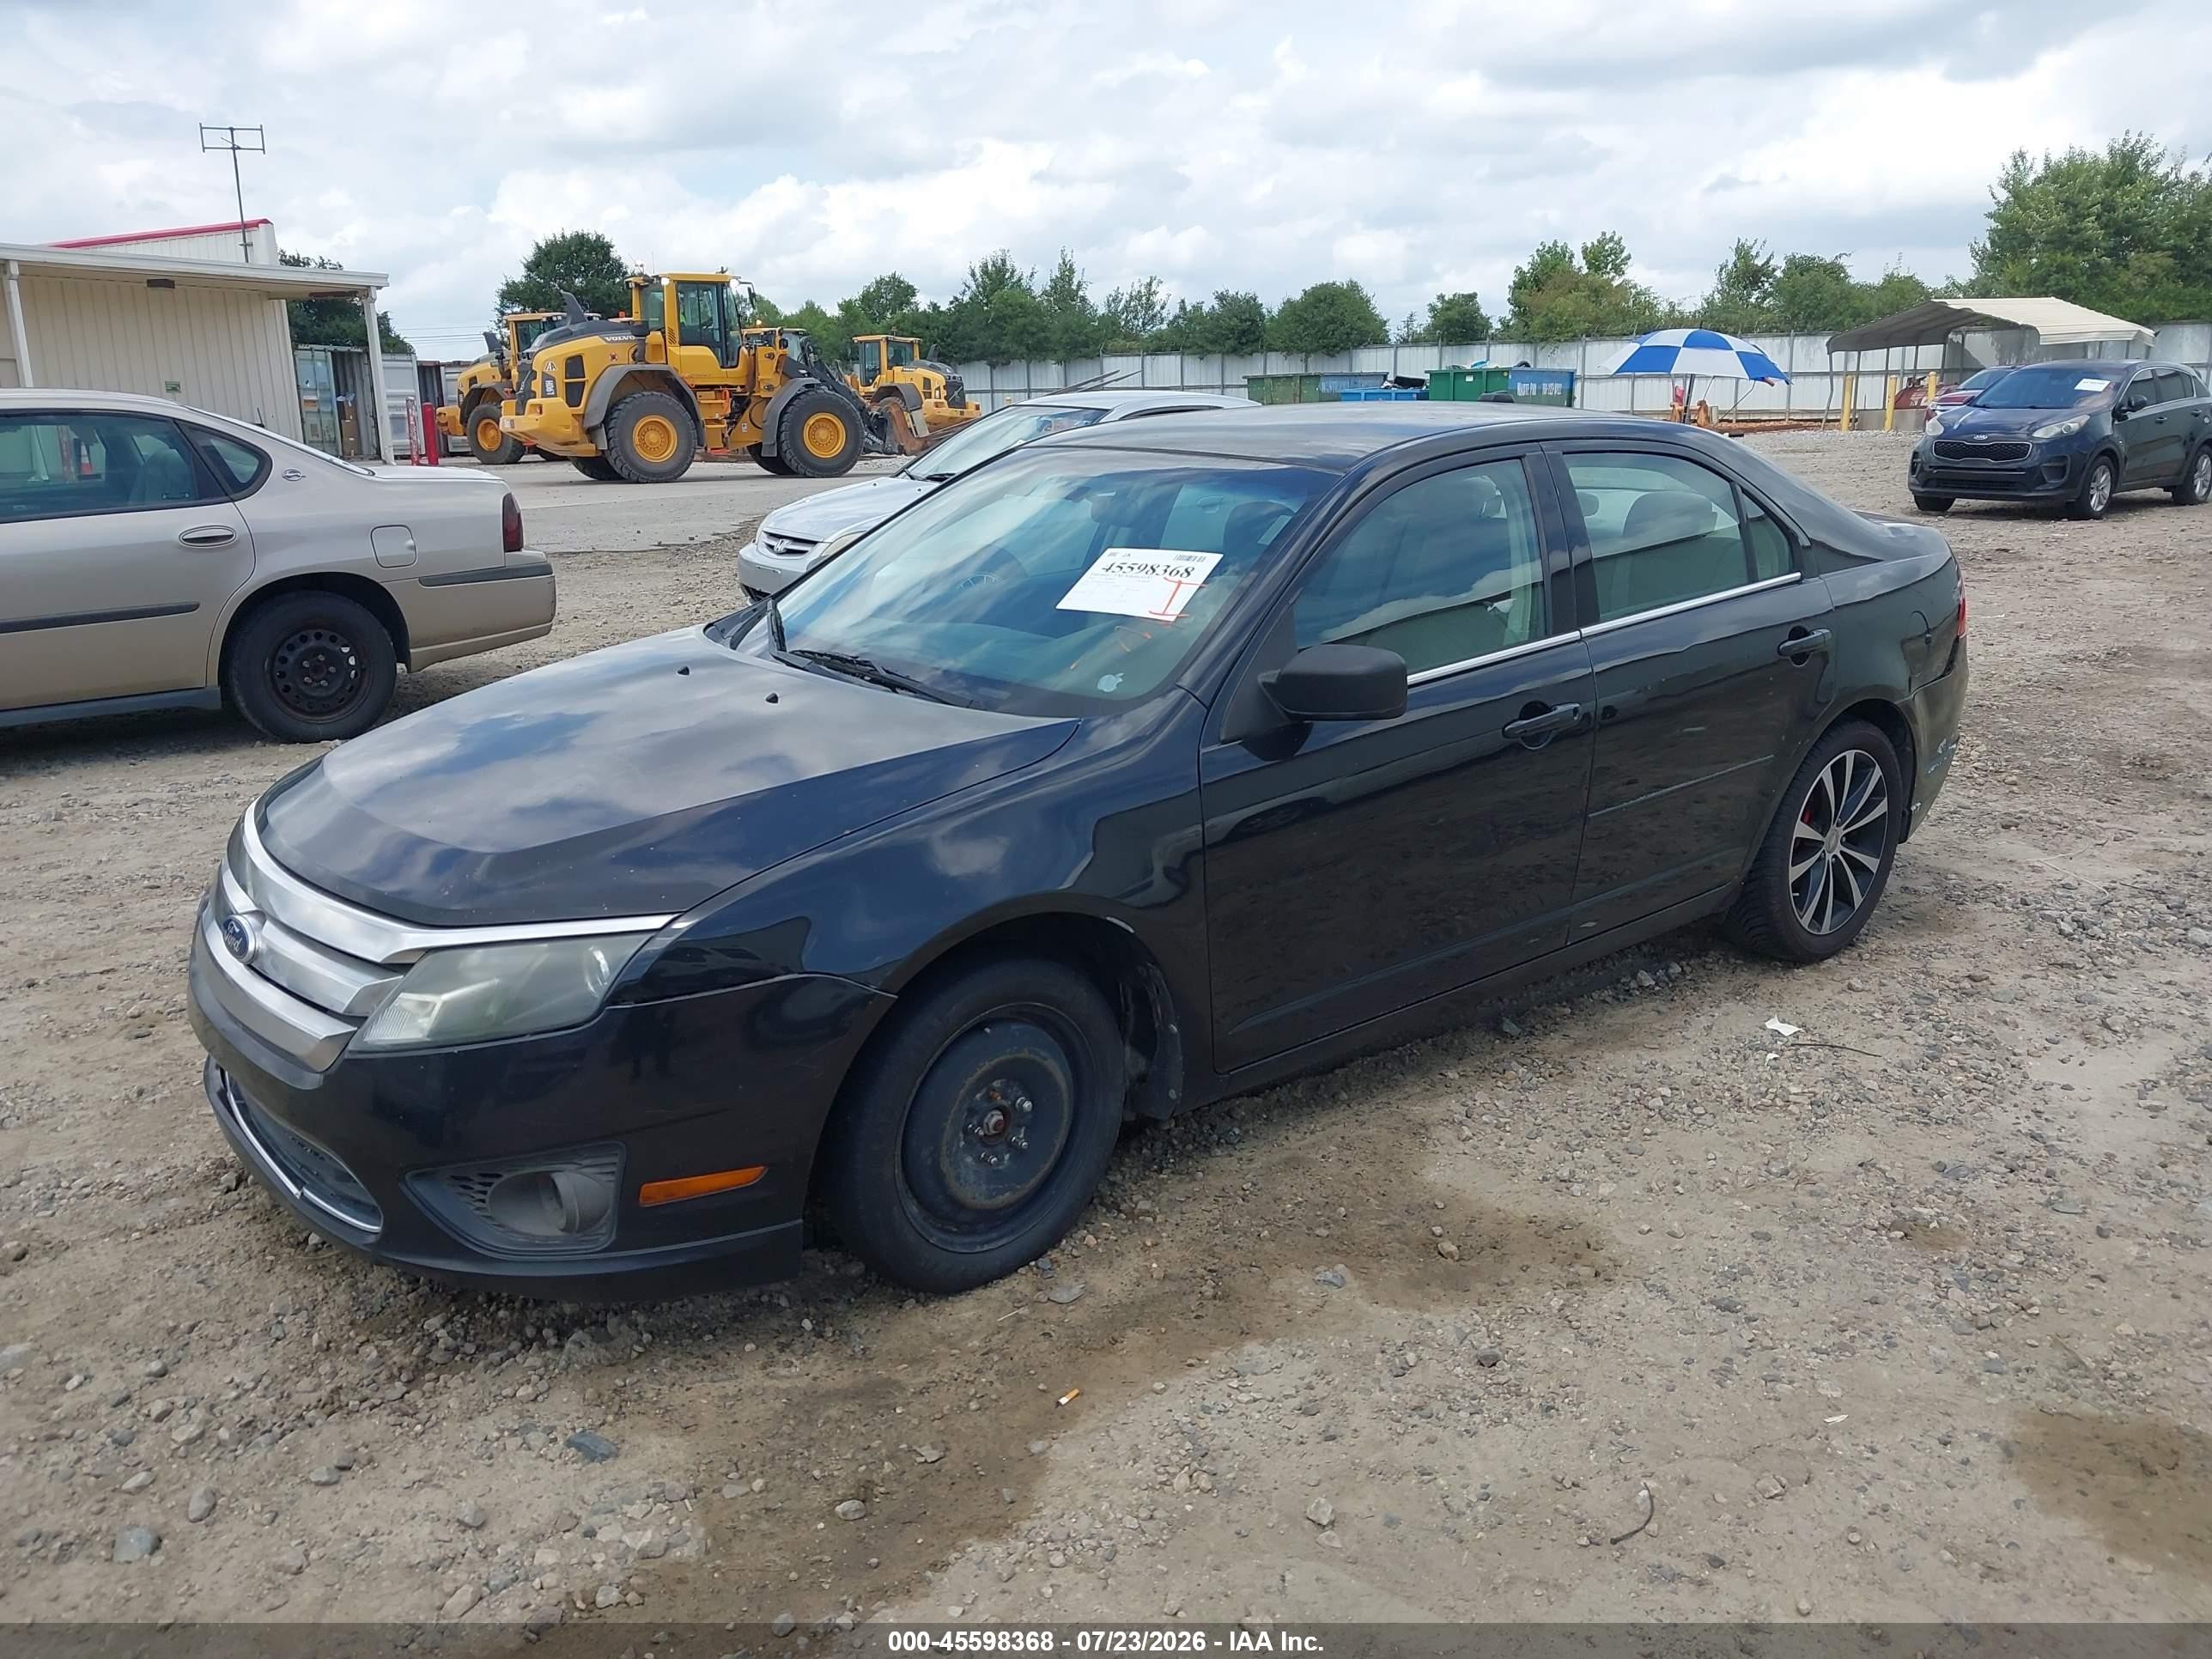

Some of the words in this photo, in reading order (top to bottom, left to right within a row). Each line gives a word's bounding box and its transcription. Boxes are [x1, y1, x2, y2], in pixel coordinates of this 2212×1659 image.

[545, 380, 555, 395] L90H
[1102, 561, 1195, 579] 45598368
[225, 921, 242, 952] Ford
